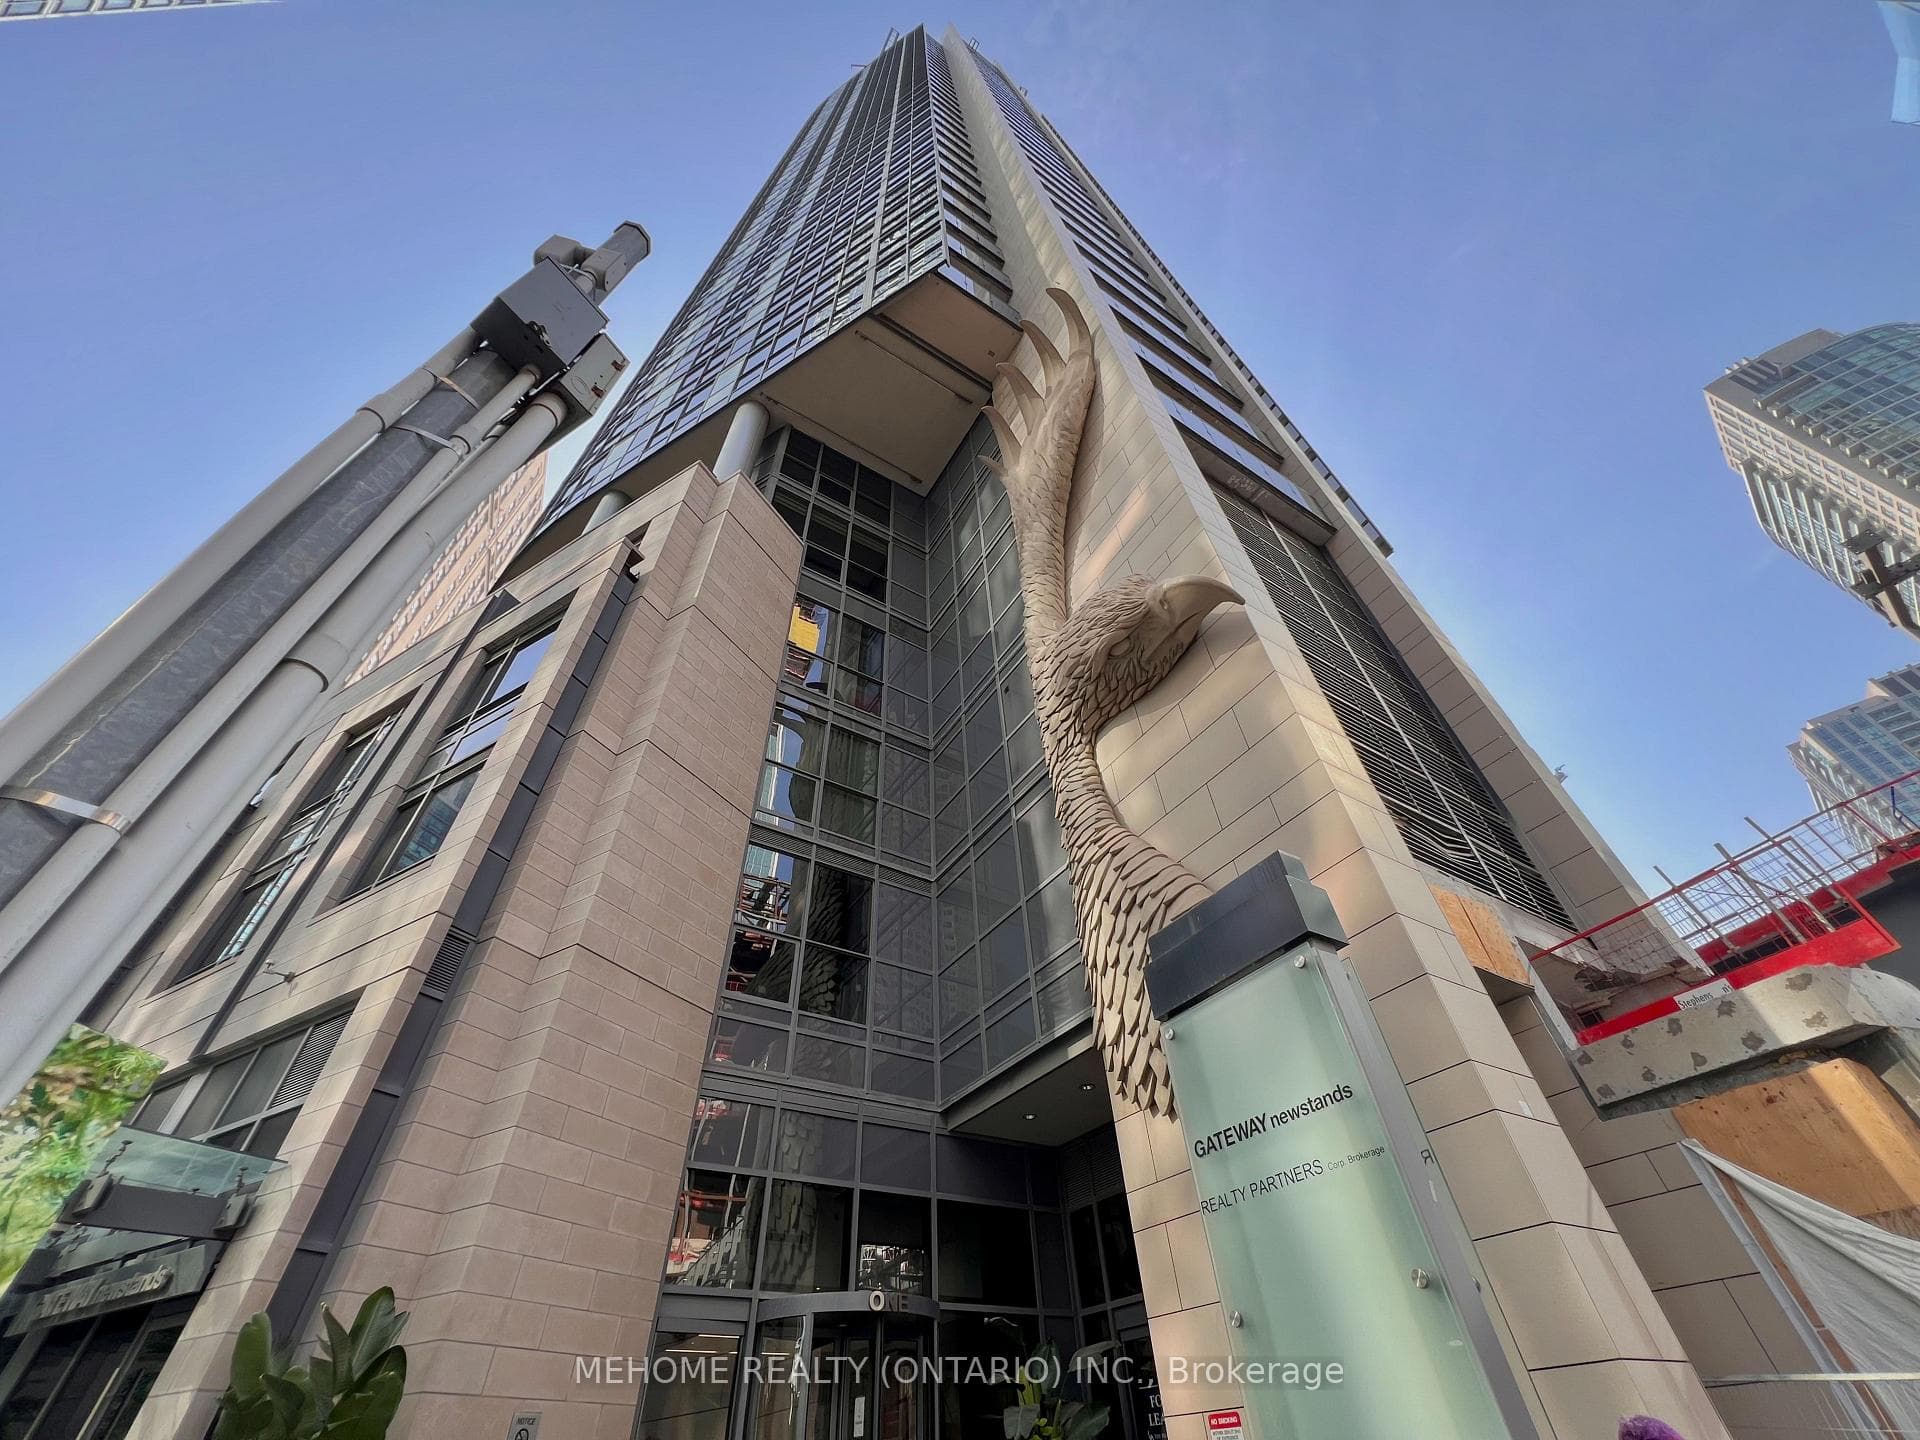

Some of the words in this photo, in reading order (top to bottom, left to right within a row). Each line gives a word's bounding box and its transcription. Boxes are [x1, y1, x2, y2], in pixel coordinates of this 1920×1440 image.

[1194, 1113, 1267, 1158] GATEWAY
[1270, 1084, 1353, 1129] newstands
[1201, 1186, 1247, 1215] REALTY
[1250, 1159, 1324, 1198] PARTNERS
[1347, 1146, 1385, 1164] Brokerage
[869, 1290, 909, 1312] ONE
